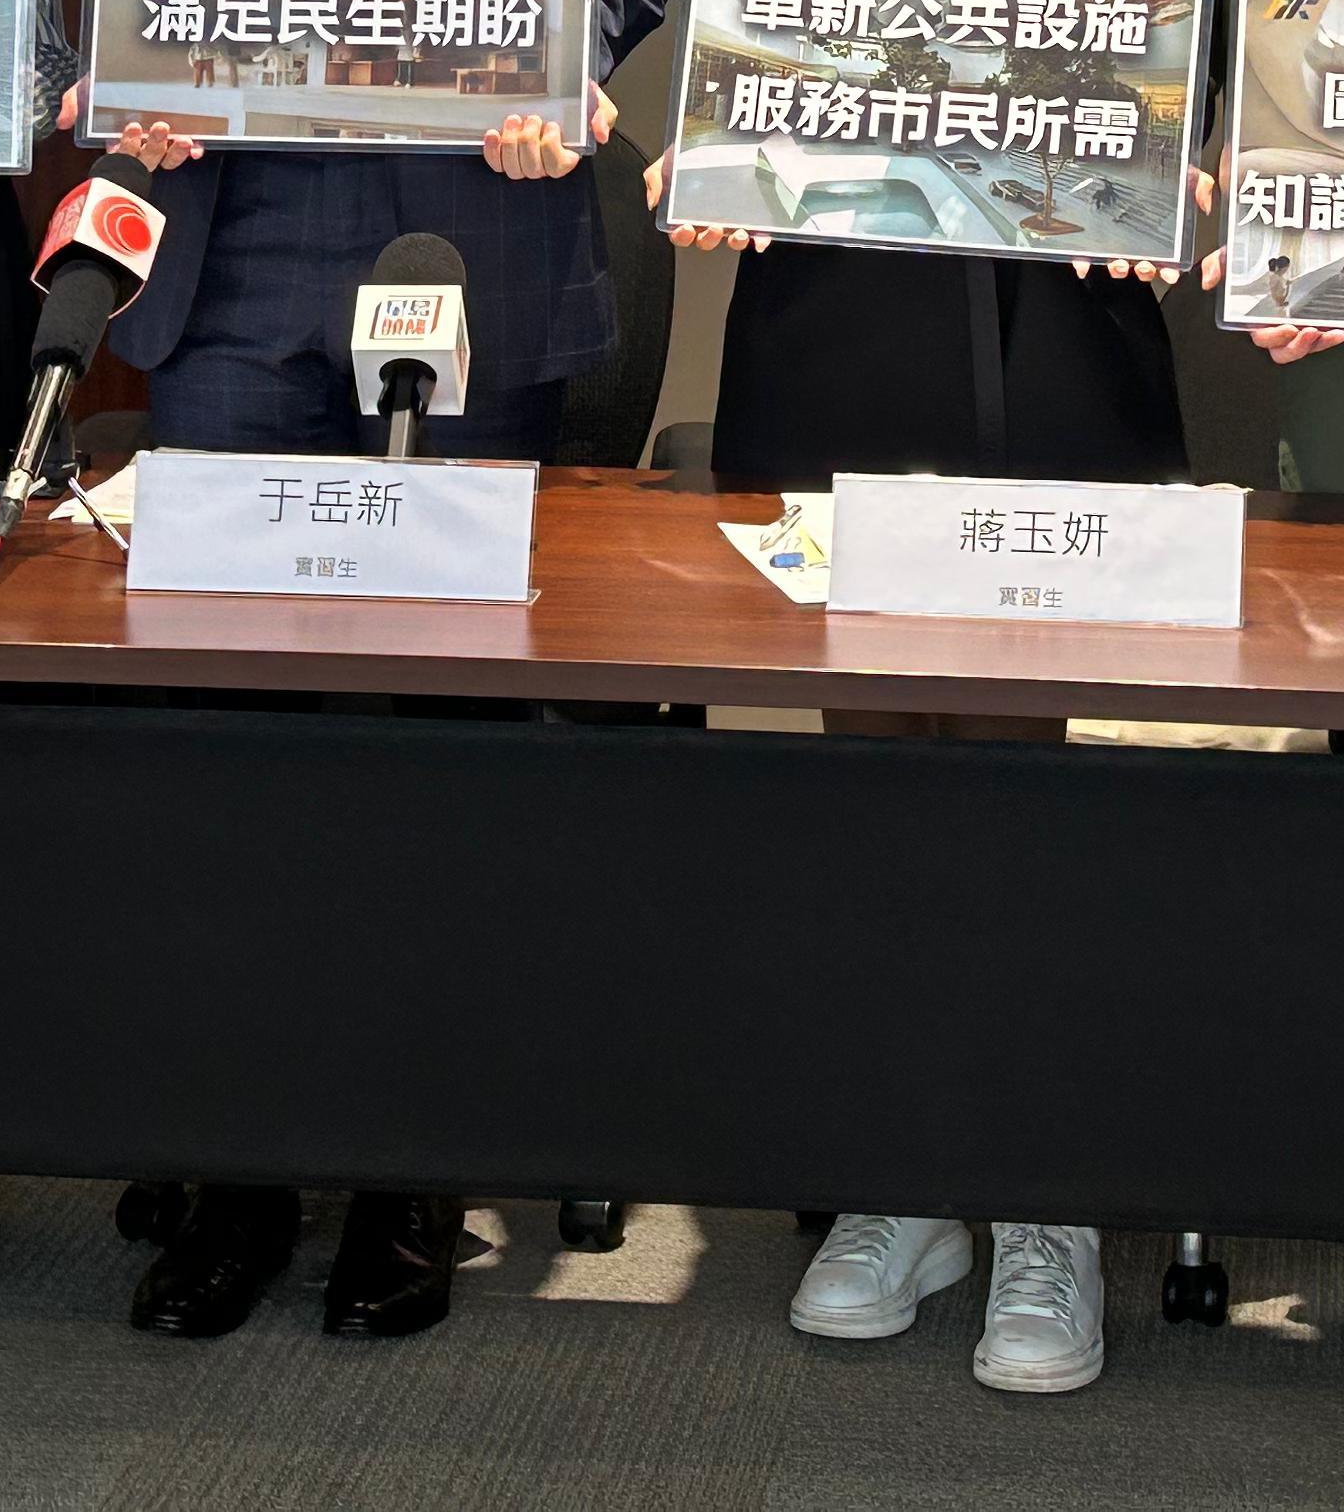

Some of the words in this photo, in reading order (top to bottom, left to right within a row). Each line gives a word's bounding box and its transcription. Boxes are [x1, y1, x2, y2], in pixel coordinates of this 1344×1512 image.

[727, 74, 1140, 159] 服務市民所需
[259, 477, 404, 526] 于岳新
[959, 508, 1109, 557] 蔣玉妍
